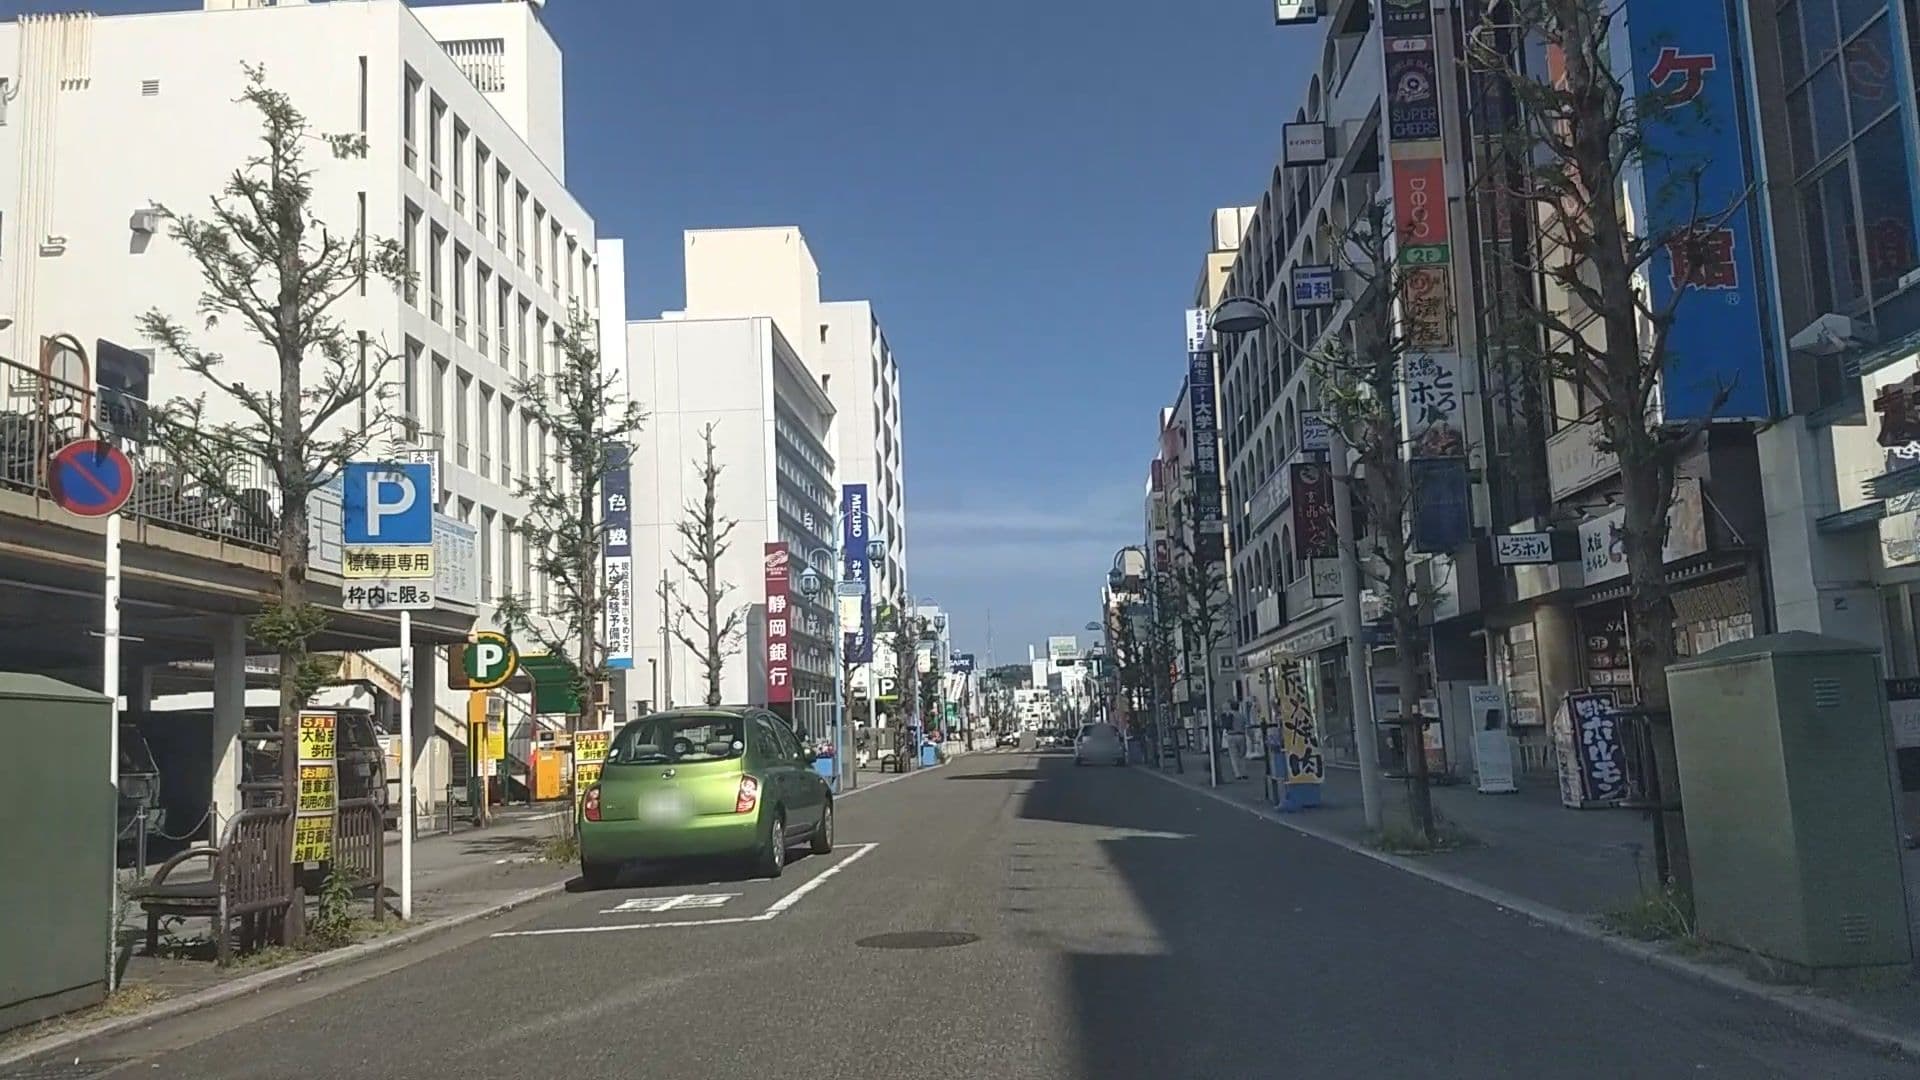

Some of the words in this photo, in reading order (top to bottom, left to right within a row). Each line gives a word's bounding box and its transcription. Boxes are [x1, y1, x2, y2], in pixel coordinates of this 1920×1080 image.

[1392, 107, 1436, 122] SUPER
[1296, 281, 1330, 300] 歯科
[366, 471, 416, 536] P
[850, 493, 863, 538] MIZUHO
[1500, 541, 1549, 557] とろホル
[347, 553, 430, 572] 標章車専用
[347, 585, 431, 605] 枠内に限る
[767, 595, 788, 686] 静岡銀行
[476, 643, 503, 678] P
[881, 679, 895, 695] P
[1280, 660, 1323, 778] 炭火焼肉
